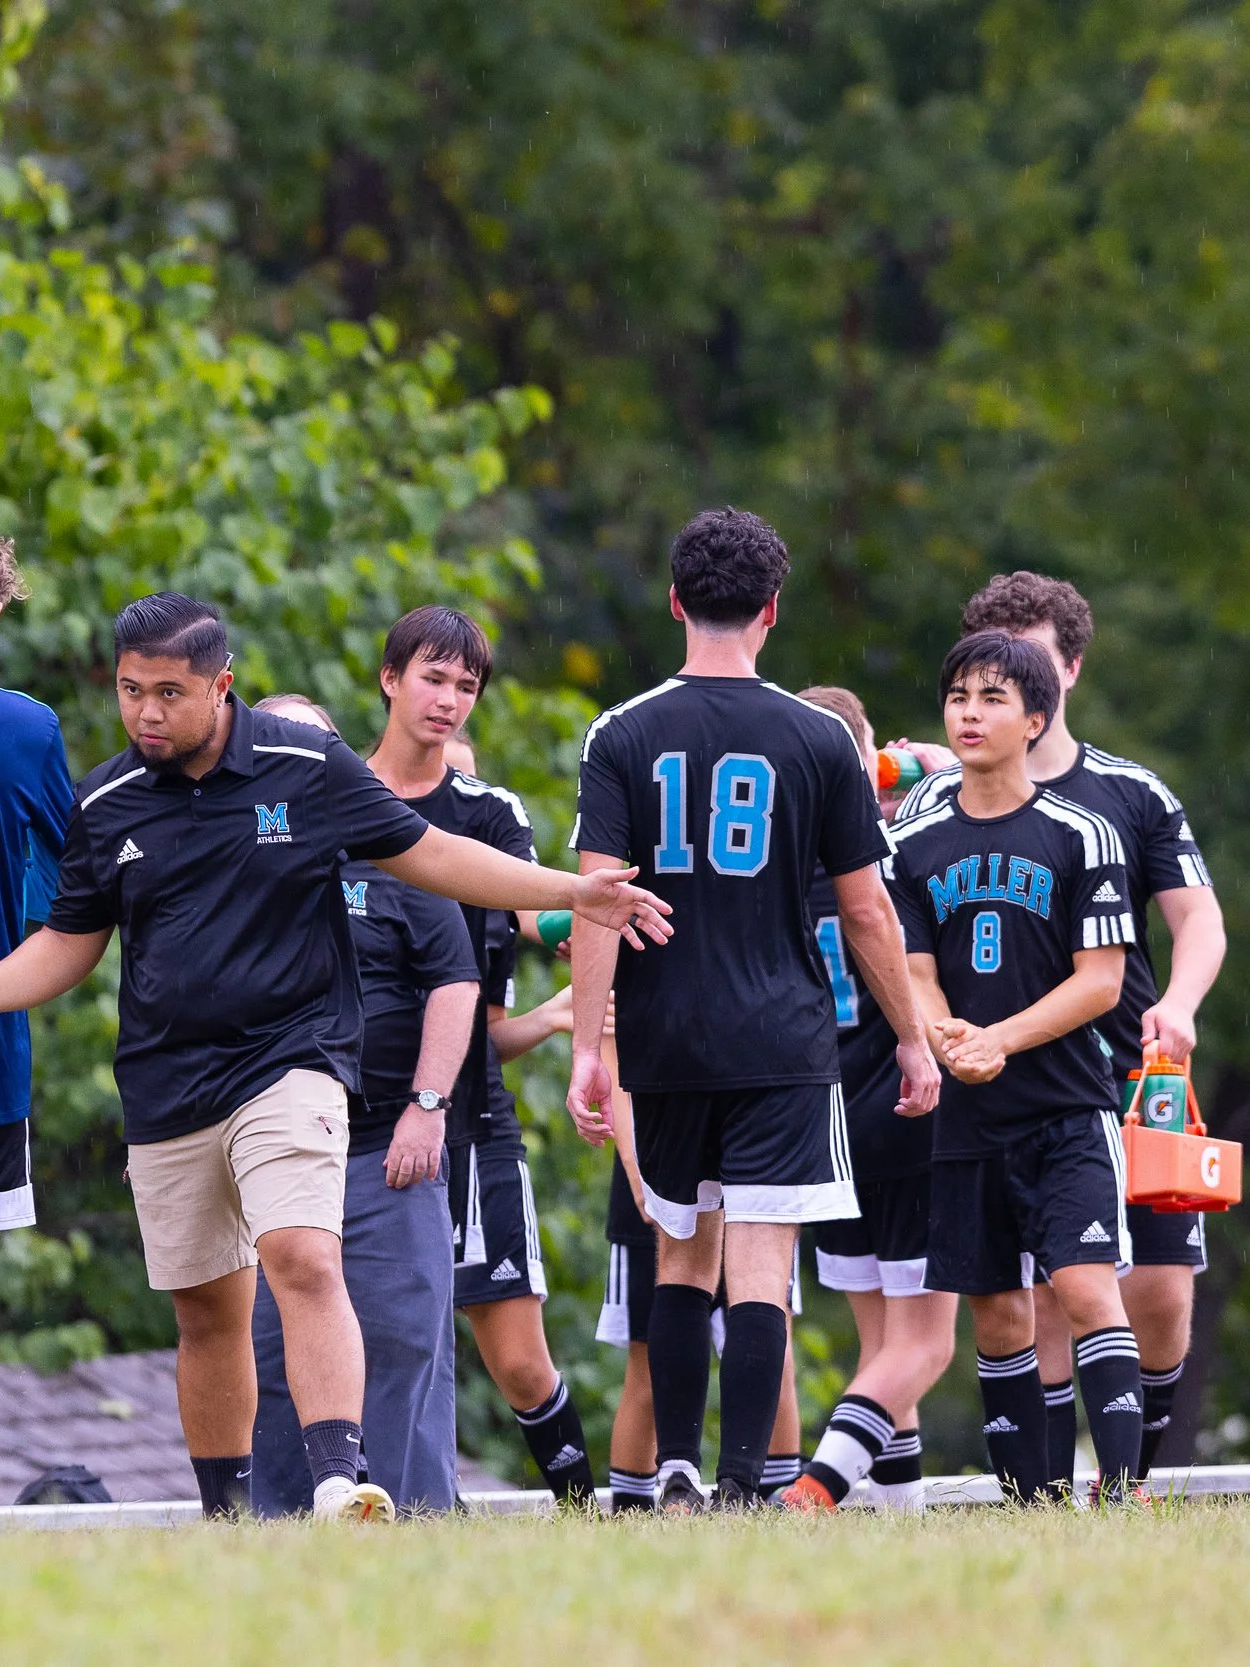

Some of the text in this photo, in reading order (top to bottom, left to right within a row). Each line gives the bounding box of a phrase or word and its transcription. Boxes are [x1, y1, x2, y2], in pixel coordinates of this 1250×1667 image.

[255, 802, 290, 834] M
[653, 751, 776, 877] 18
[257, 835, 293, 844] ATHLETICS
[117, 850, 144, 864] adidas
[927, 853, 1053, 924] MILLER
[1092, 894, 1122, 902] adidas
[972, 911, 1001, 973] 8
[1148, 1092, 1173, 1123] G
[1201, 1146, 1221, 1189] G
[1080, 1234, 1111, 1243] adidas
[490, 1270, 521, 1281] adidas
[1102, 1404, 1141, 1413] adidas
[547, 1450, 584, 1470] adidas
